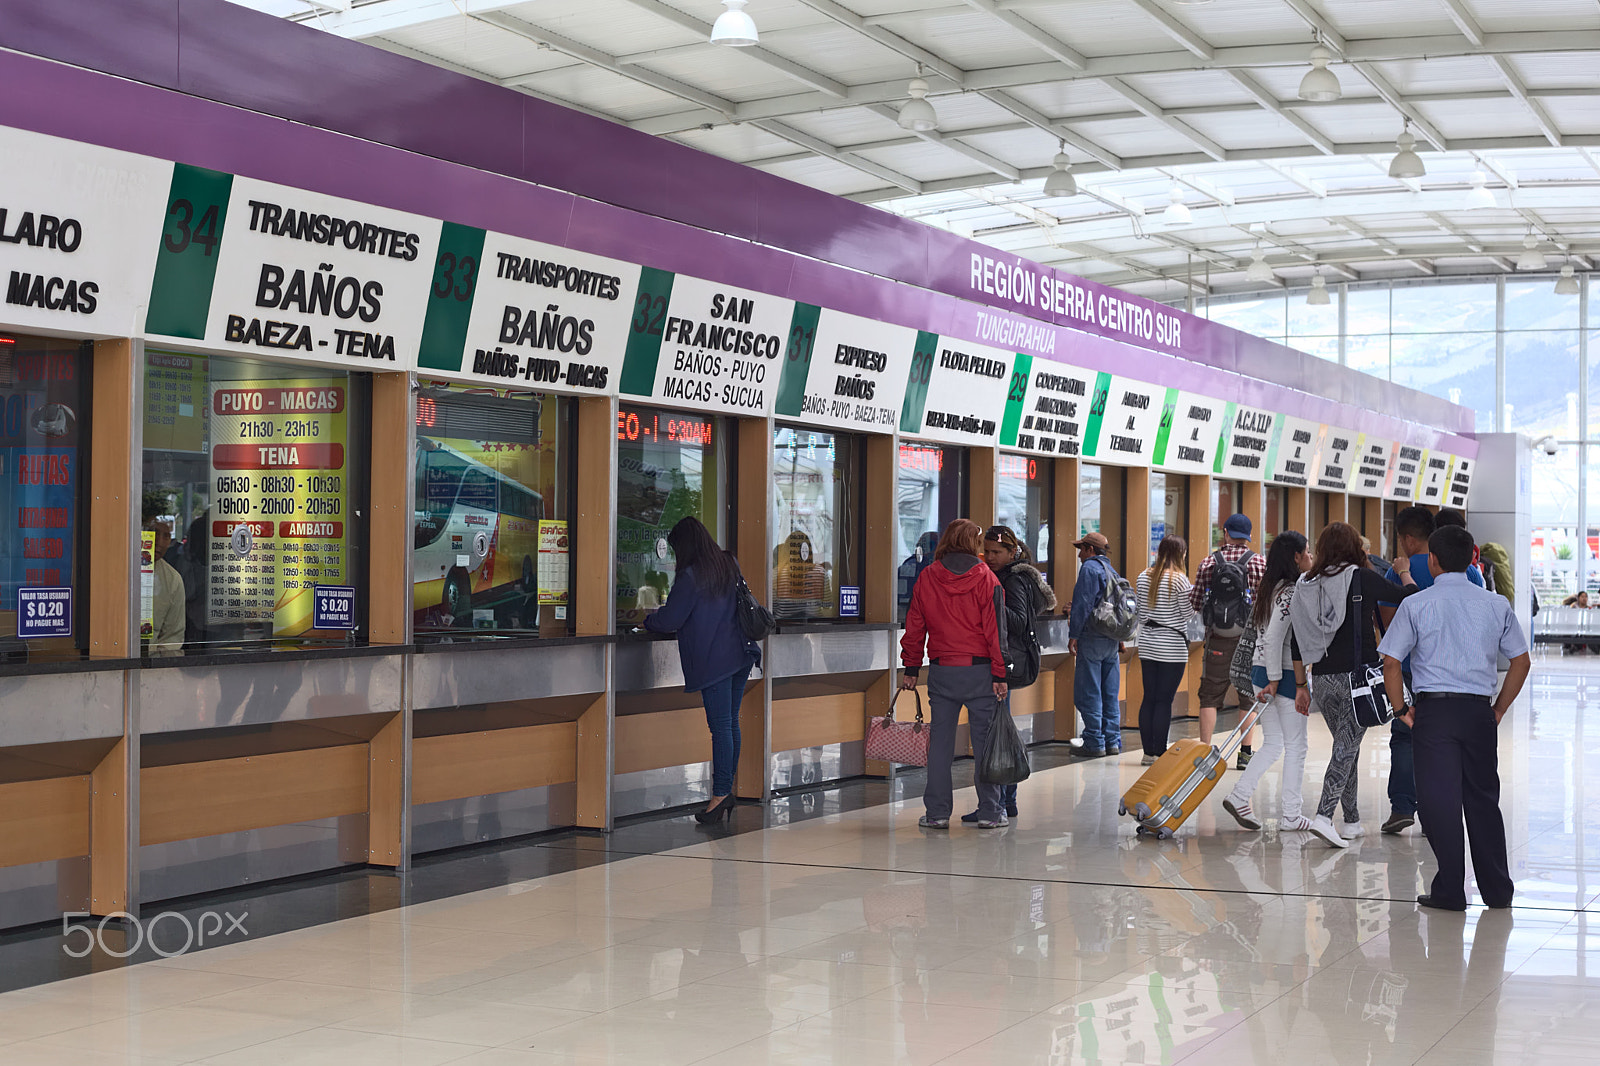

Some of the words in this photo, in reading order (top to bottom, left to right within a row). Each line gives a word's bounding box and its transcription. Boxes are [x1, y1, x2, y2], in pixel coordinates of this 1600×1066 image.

[164, 198, 220, 257] 34
[248, 199, 420, 261] TRANSPORTES
[434, 251, 476, 302] 33
[496, 251, 621, 301] TRANSPORTES
[6, 271, 99, 314] MACAS
[255, 262, 384, 323] BAÑOS
[970, 252, 1036, 307] REGIÓN
[1039, 275, 1096, 324] SIERRA
[1099, 294, 1153, 341] CENTRO
[1155, 312, 1182, 348] SUR
[633, 292, 667, 337] 32
[710, 293, 755, 325] SAN
[224, 314, 313, 351] BAEZA
[334, 328, 396, 361] TENA
[498, 303, 595, 355] BAÑOS
[664, 316, 781, 360] FRANCISCO
[789, 325, 814, 363] 31
[975, 311, 1056, 355] TUNGURAHUA
[13, 354, 75, 381] SPORTES
[674, 350, 722, 377] BAÑOS
[731, 359, 766, 384] PUYO
[834, 343, 887, 373] EXPRESO
[910, 351, 933, 385] 30
[940, 349, 969, 373] FLOTA
[221, 392, 263, 411] PUYO
[280, 391, 338, 410] MACAS
[663, 376, 712, 402] MACAS
[721, 384, 763, 410] SUCUA
[834, 374, 876, 400] BAÑOS
[1008, 372, 1028, 403] 29
[1090, 388, 1107, 416] 28
[801, 393, 827, 415] BAÑOS
[830, 400, 851, 420] PUYO
[854, 404, 876, 423] BAEZA
[1159, 403, 1175, 428] 27
[239, 421, 274, 438] 21h30
[285, 420, 319, 438] 23h15
[18, 454, 70, 486] RUTAS
[258, 447, 299, 466] TENA
[217, 476, 250, 493] 05h30
[261, 476, 295, 493] 08h30
[306, 476, 341, 493] 10h30
[18, 507, 68, 529] LATACUNGA
[217, 497, 249, 514] 19h00
[260, 497, 295, 514] 20h00
[306, 497, 341, 515] 20h50
[289, 523, 334, 536] AMBATO
[23, 537, 63, 559] SALCEDO
[27, 601, 35, 618] $
[38, 601, 64, 618] 0,20
[330, 599, 348, 612] 0,20
[25, 619, 34, 627] NO
